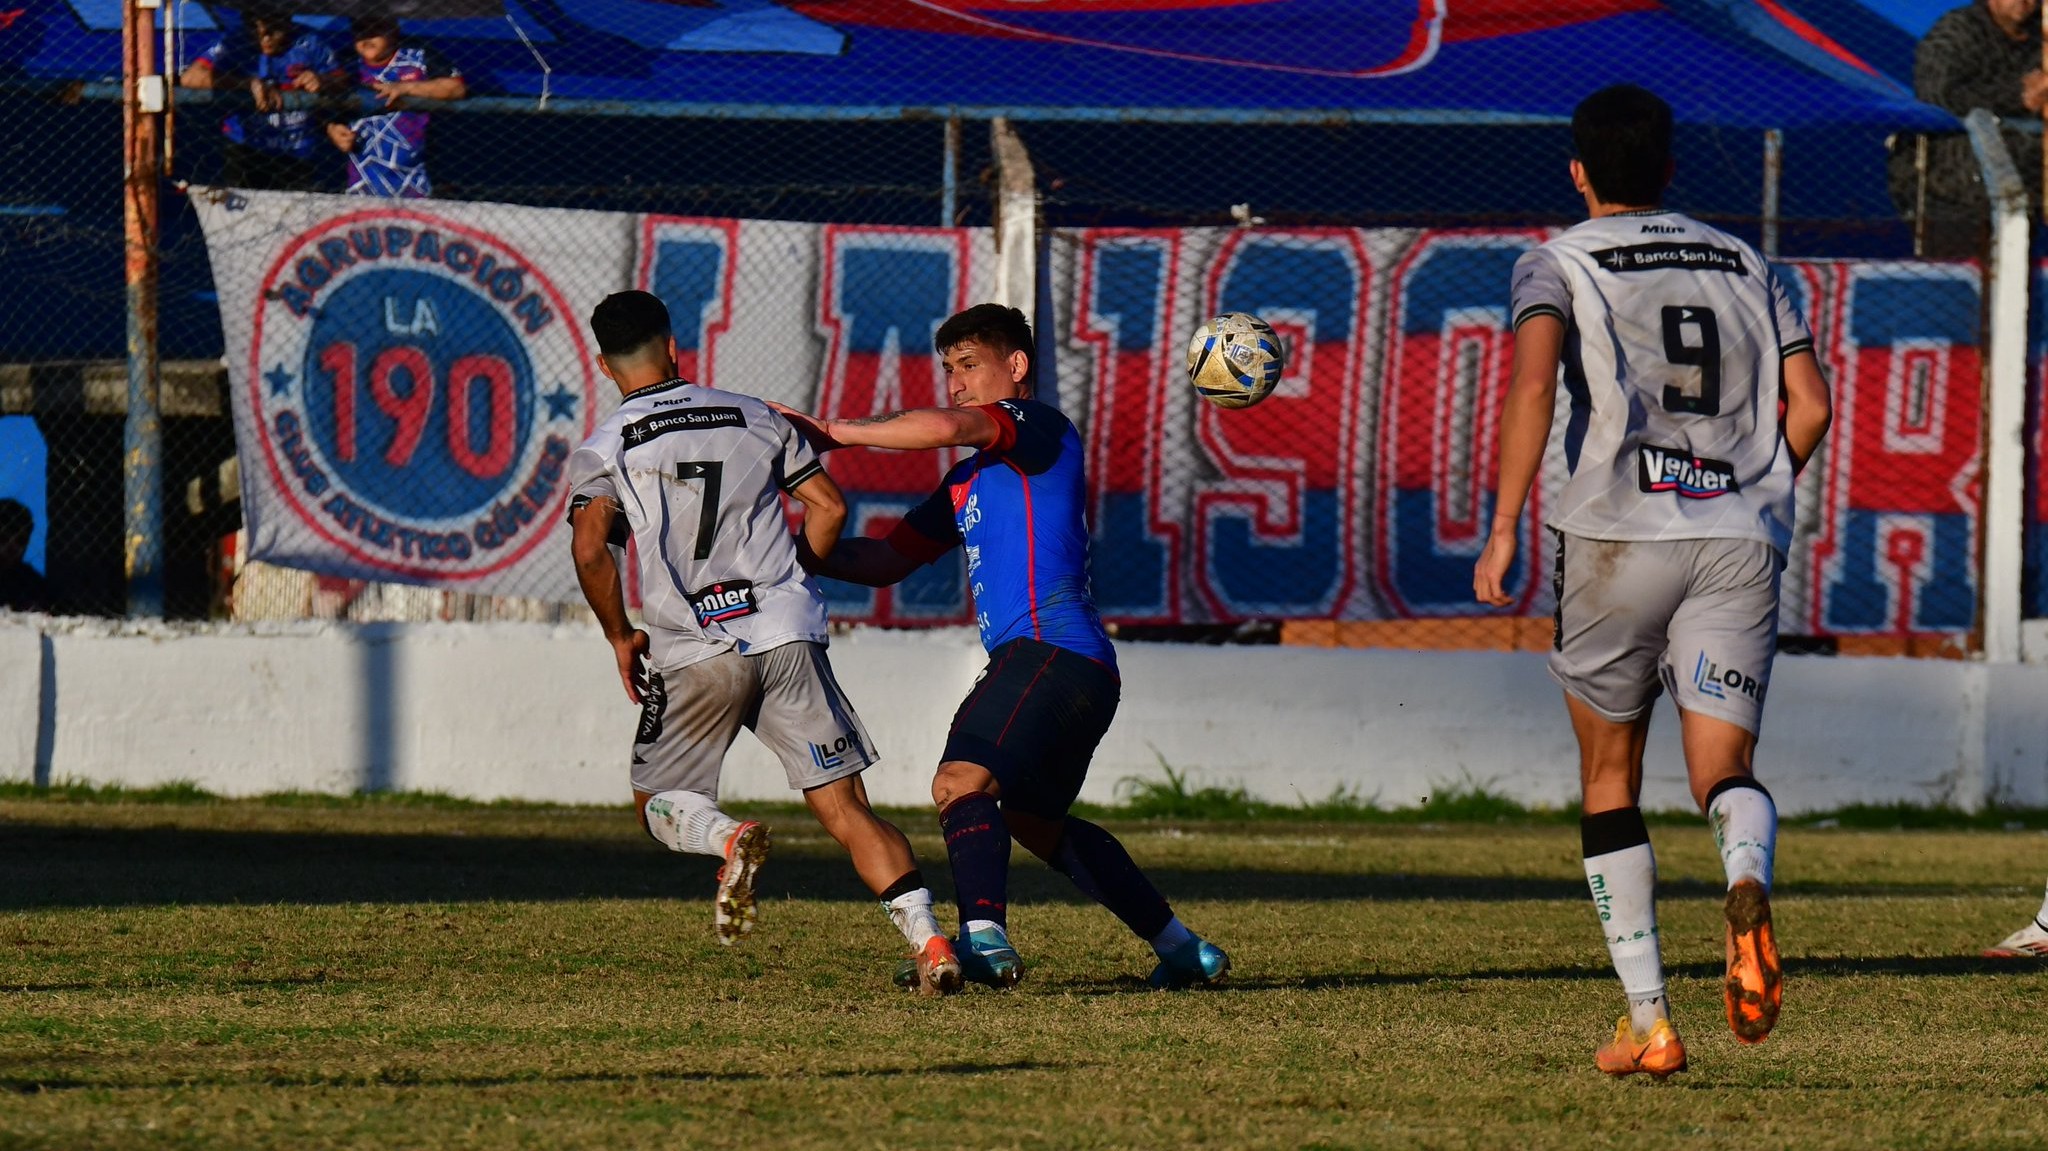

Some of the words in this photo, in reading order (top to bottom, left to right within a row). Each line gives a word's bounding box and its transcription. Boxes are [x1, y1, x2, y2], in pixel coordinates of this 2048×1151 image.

[1634, 251, 1678, 264] Banco
[1679, 249, 1706, 263] San
[280, 226, 554, 334] AGRUPACIÓN
[385, 296, 438, 336] LA
[1661, 305, 1720, 416] 9
[320, 342, 516, 479] 190
[649, 416, 686, 431] Banco
[687, 413, 709, 424] San
[711, 412, 738, 423] Juan
[1642, 449, 1732, 490] Venier
[676, 461, 723, 560] 7
[696, 584, 749, 615] nier
[1590, 873, 1613, 921] mitre
